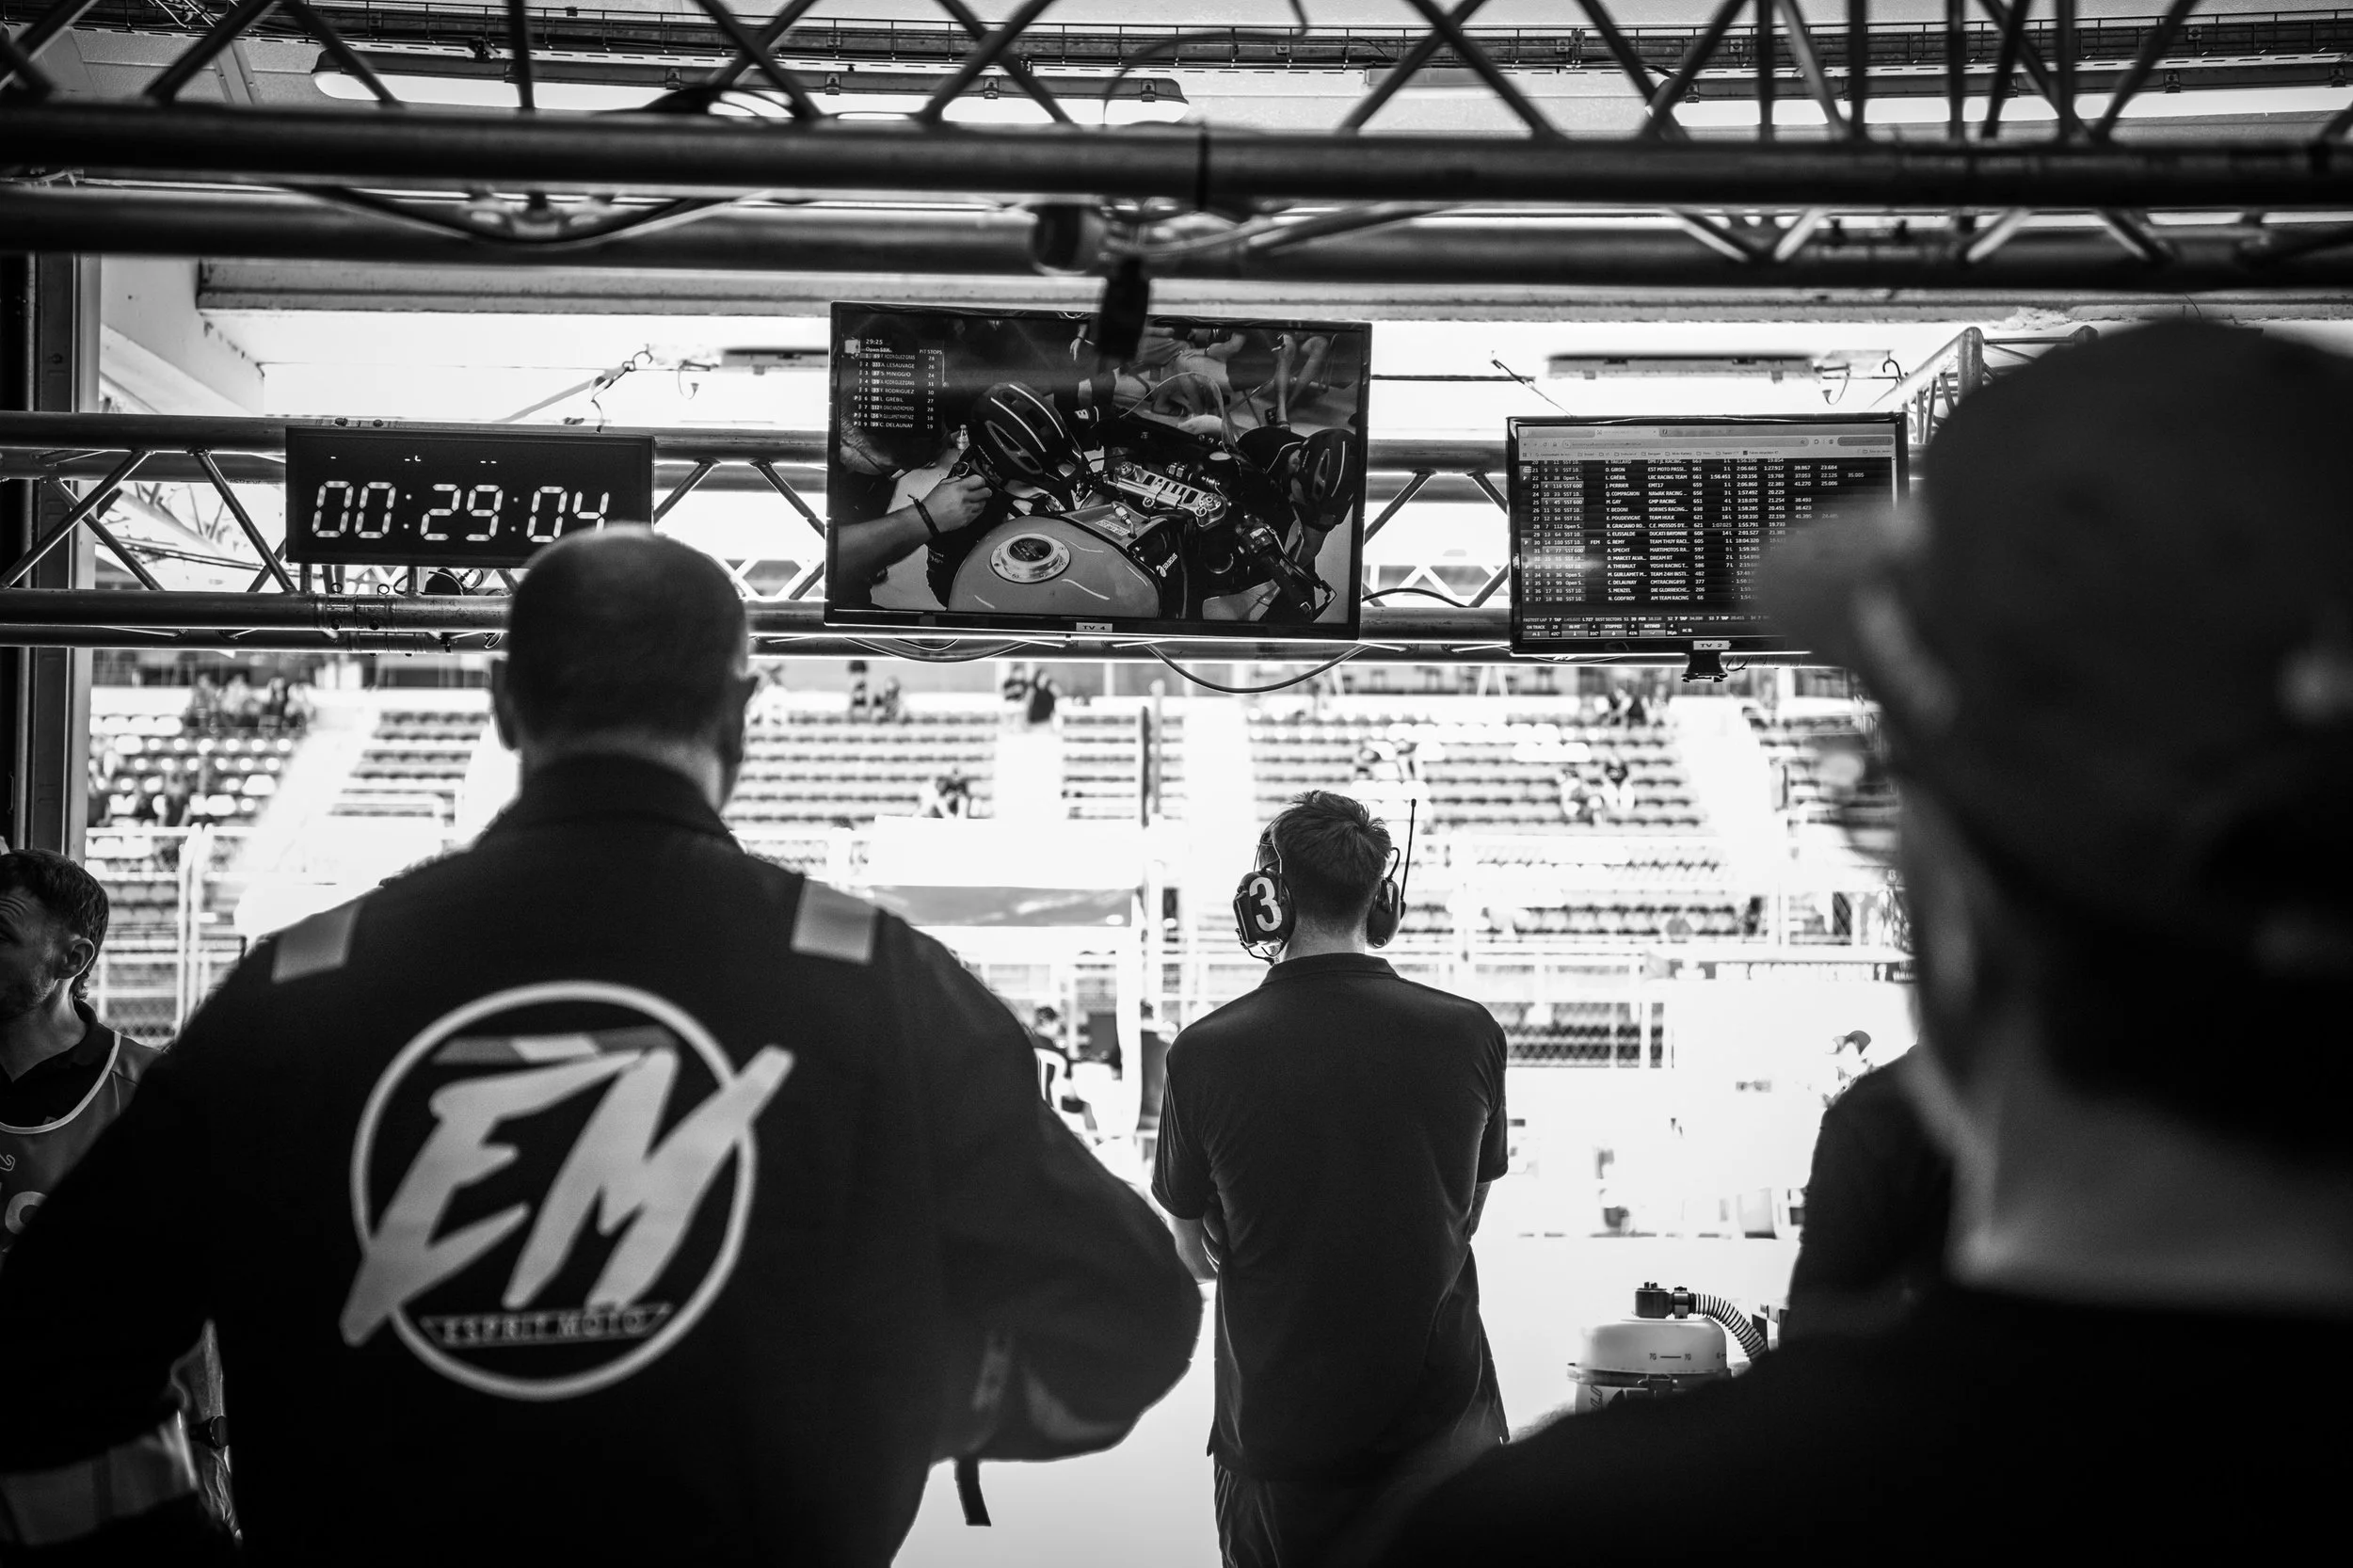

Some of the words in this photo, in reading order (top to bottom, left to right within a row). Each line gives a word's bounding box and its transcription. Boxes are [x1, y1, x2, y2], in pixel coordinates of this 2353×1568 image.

[312, 481, 610, 543] 00:29:04
[1249, 876, 1282, 932] 3
[339, 1045, 795, 1347] EM
